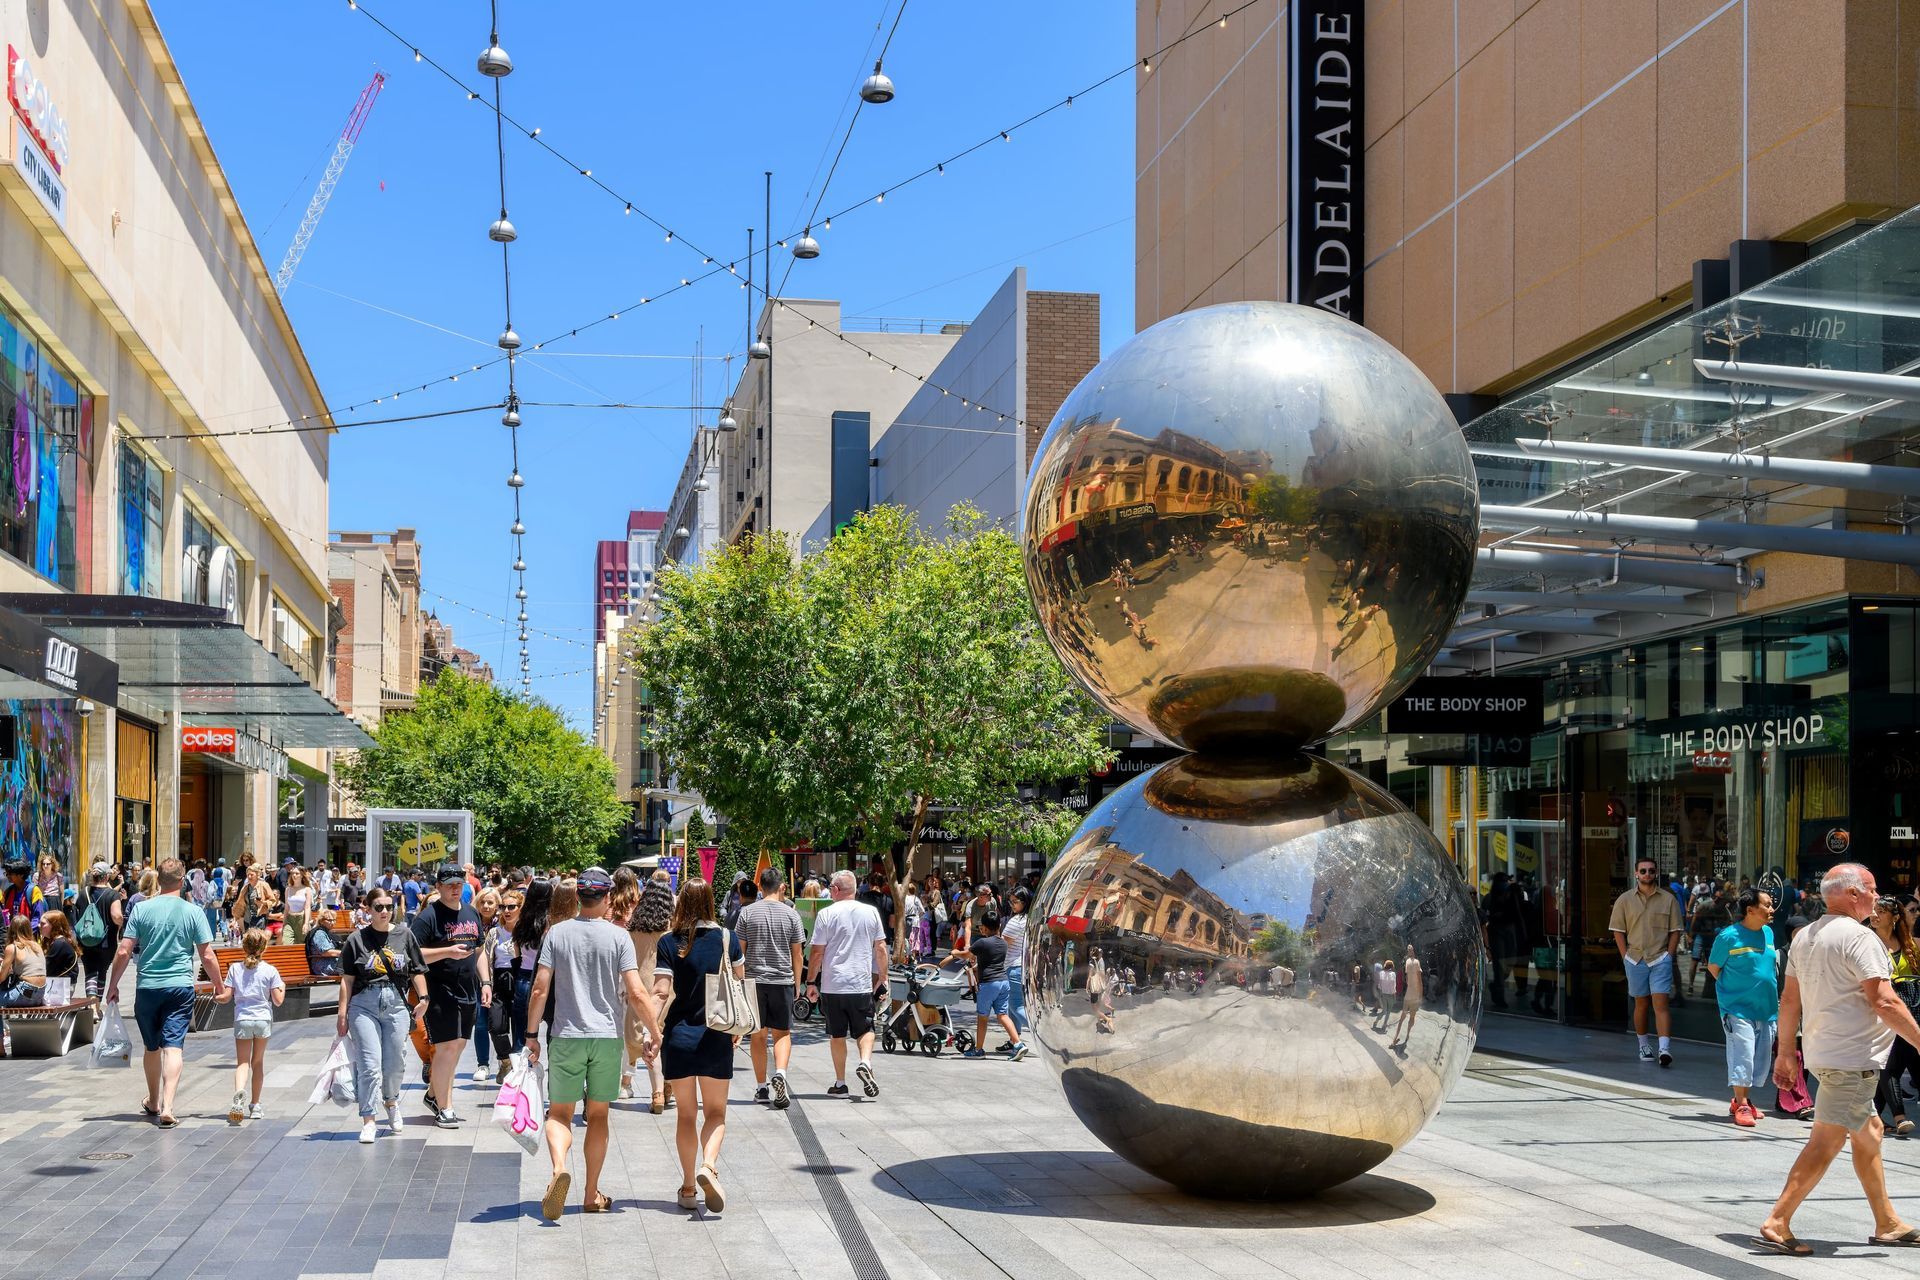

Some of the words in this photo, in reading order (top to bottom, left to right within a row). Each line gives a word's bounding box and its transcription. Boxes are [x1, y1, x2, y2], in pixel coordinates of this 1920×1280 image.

[1314, 13, 1351, 319] ADELAIDE
[23, 144, 37, 178] CITY
[38, 164, 61, 212] LIBRARY
[1405, 698, 1435, 711] THE
[1440, 698, 1481, 711] BODY
[1485, 698, 1527, 711] SHOP
[182, 730, 234, 746] coles
[1660, 730, 1695, 758] THE
[1703, 723, 1757, 754] BODY
[1763, 714, 1823, 747] SHOP
[1063, 794, 1089, 809] SEPHORA
[334, 823, 367, 831] micha
